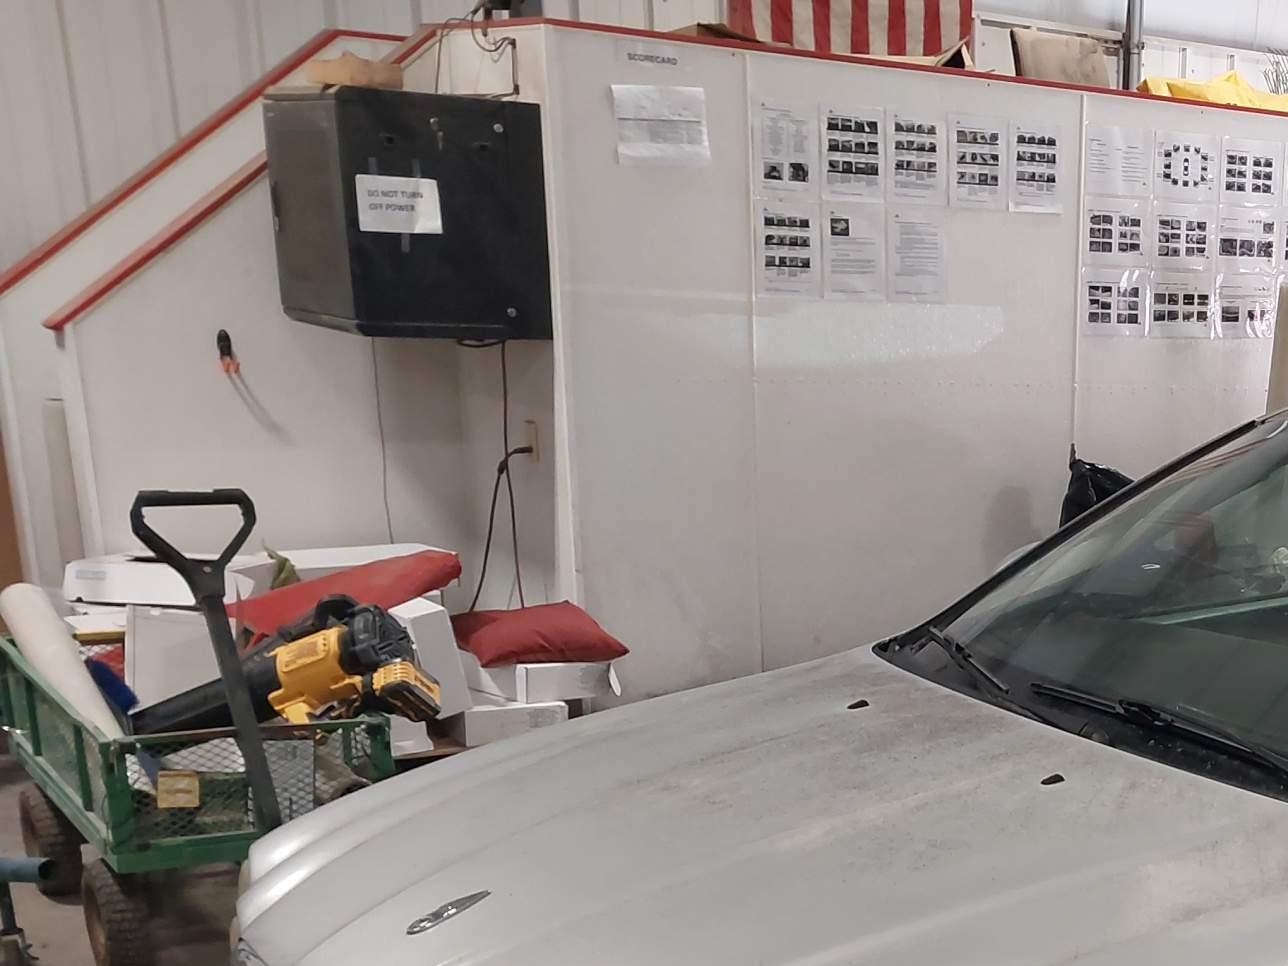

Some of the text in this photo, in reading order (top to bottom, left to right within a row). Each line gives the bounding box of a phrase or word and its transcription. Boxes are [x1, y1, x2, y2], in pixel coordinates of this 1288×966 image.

[626, 52, 679, 66] SCORECARD
[380, 190, 398, 199] NOT
[368, 203, 416, 212] OFF POWER
